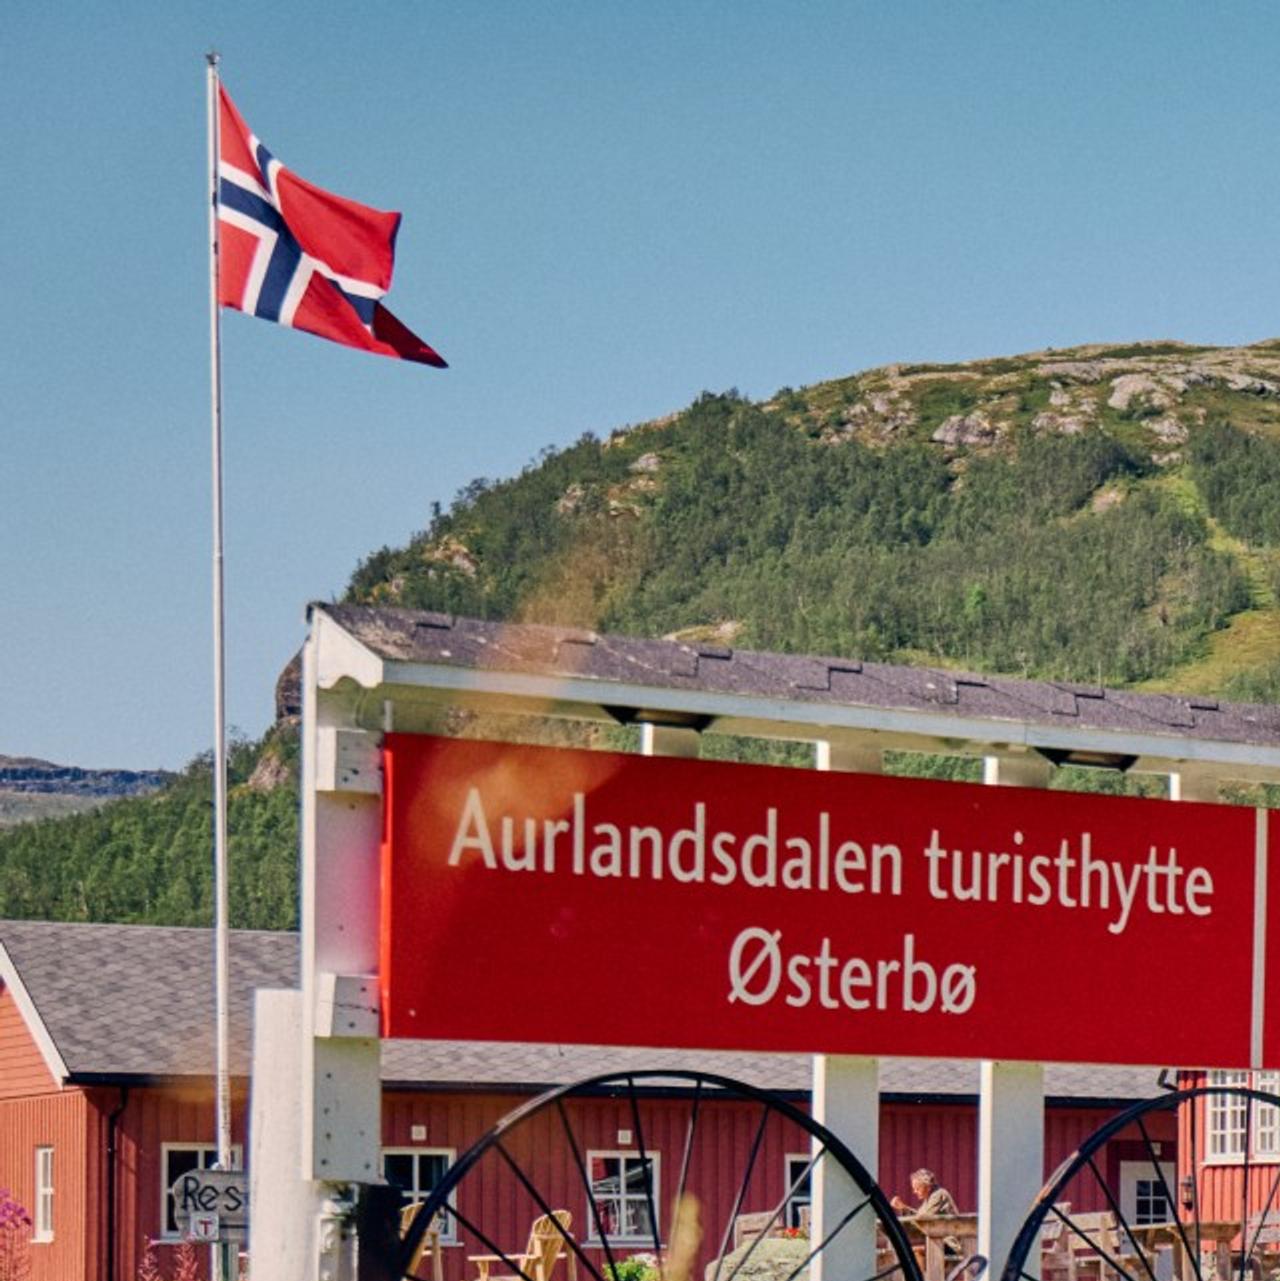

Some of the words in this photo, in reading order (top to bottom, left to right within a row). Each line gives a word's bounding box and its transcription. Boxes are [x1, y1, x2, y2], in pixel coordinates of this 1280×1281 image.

[448, 788, 902, 895] Aurlandsdalen
[924, 829, 1214, 934] turisthytte
[728, 926, 976, 1014] Østerbø
